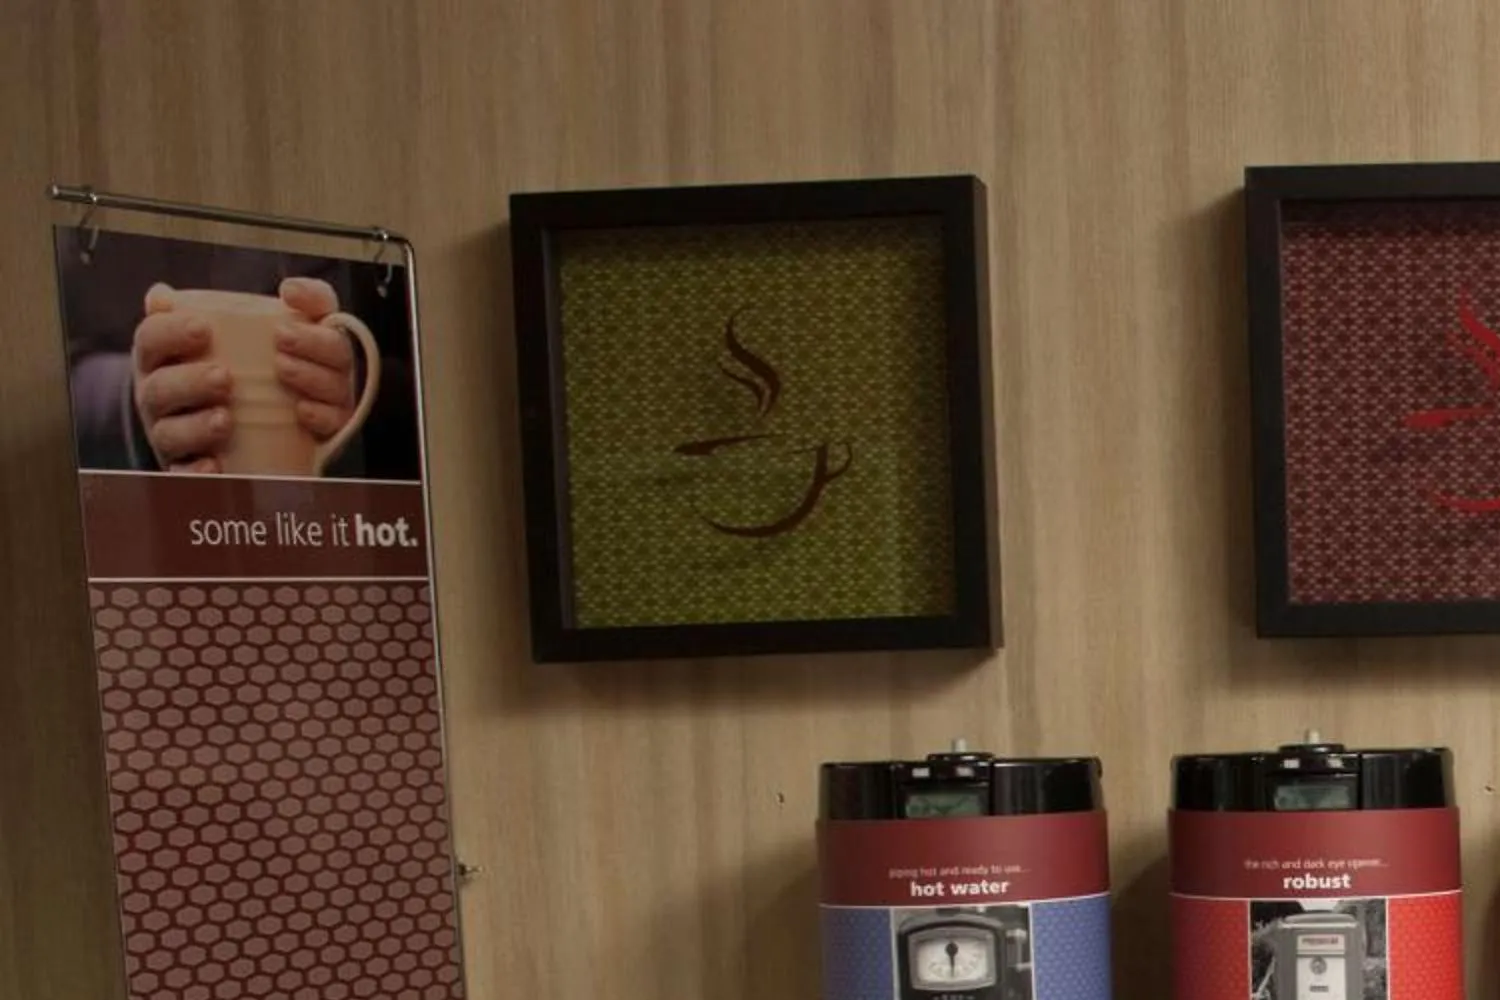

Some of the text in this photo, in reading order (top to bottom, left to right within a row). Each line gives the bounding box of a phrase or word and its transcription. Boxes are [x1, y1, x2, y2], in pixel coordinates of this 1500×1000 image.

[189, 511, 418, 547] some like it hot.
[939, 865, 960, 876] and
[1282, 859, 1300, 869] and
[910, 880, 1010, 897] hot water
[1283, 872, 1351, 889] robust
